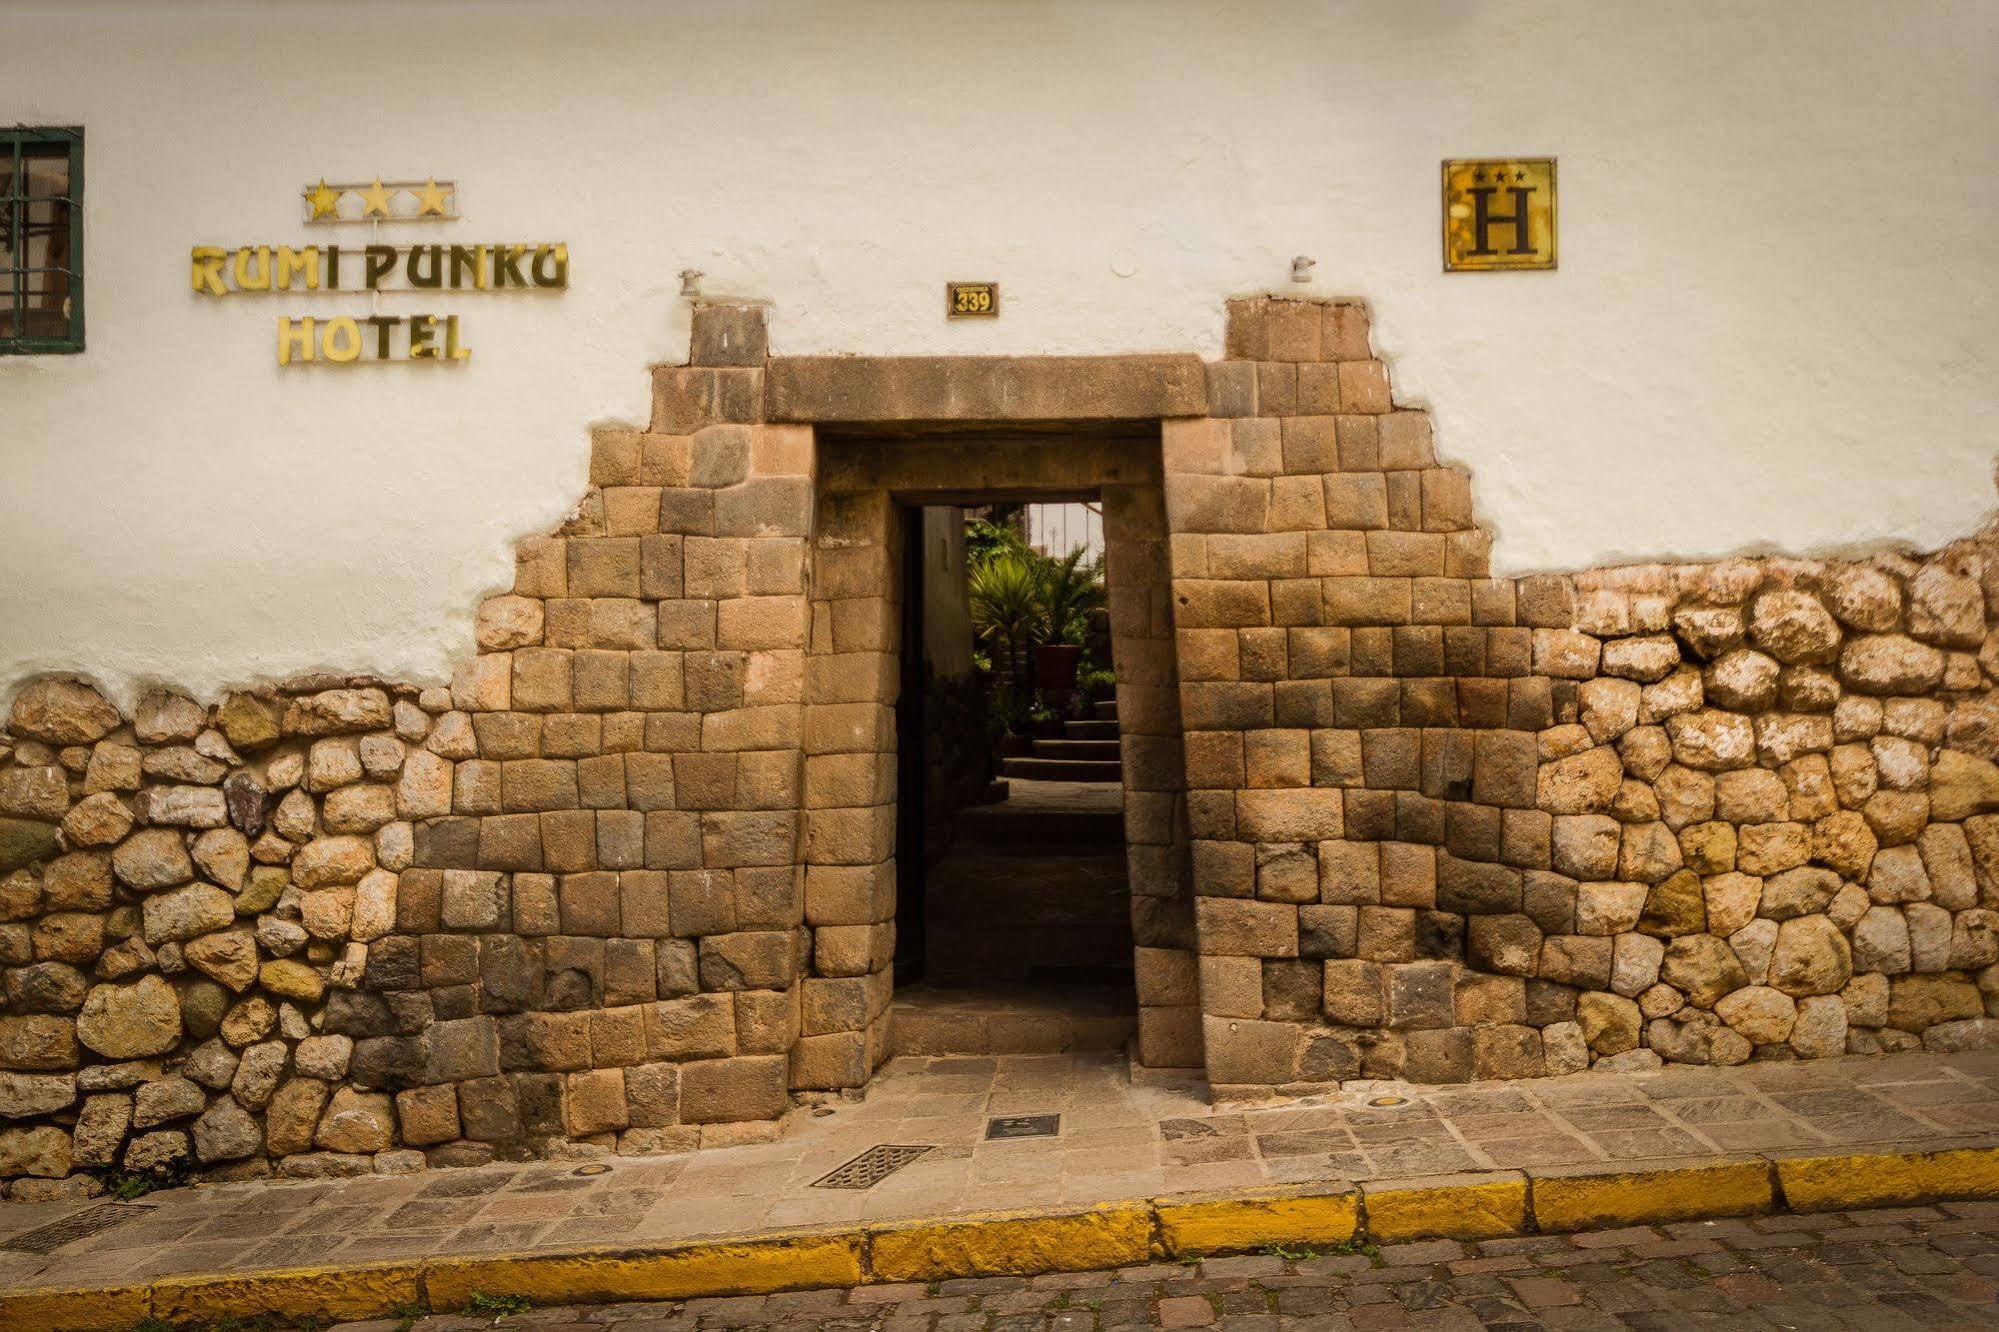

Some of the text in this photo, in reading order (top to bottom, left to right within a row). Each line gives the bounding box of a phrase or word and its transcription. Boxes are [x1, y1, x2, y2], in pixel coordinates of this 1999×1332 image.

[1466, 187, 1538, 255] H
[191, 243, 569, 296] RUMI PUNKU
[956, 292, 990, 311] 339
[278, 314, 472, 366] HOTEL
